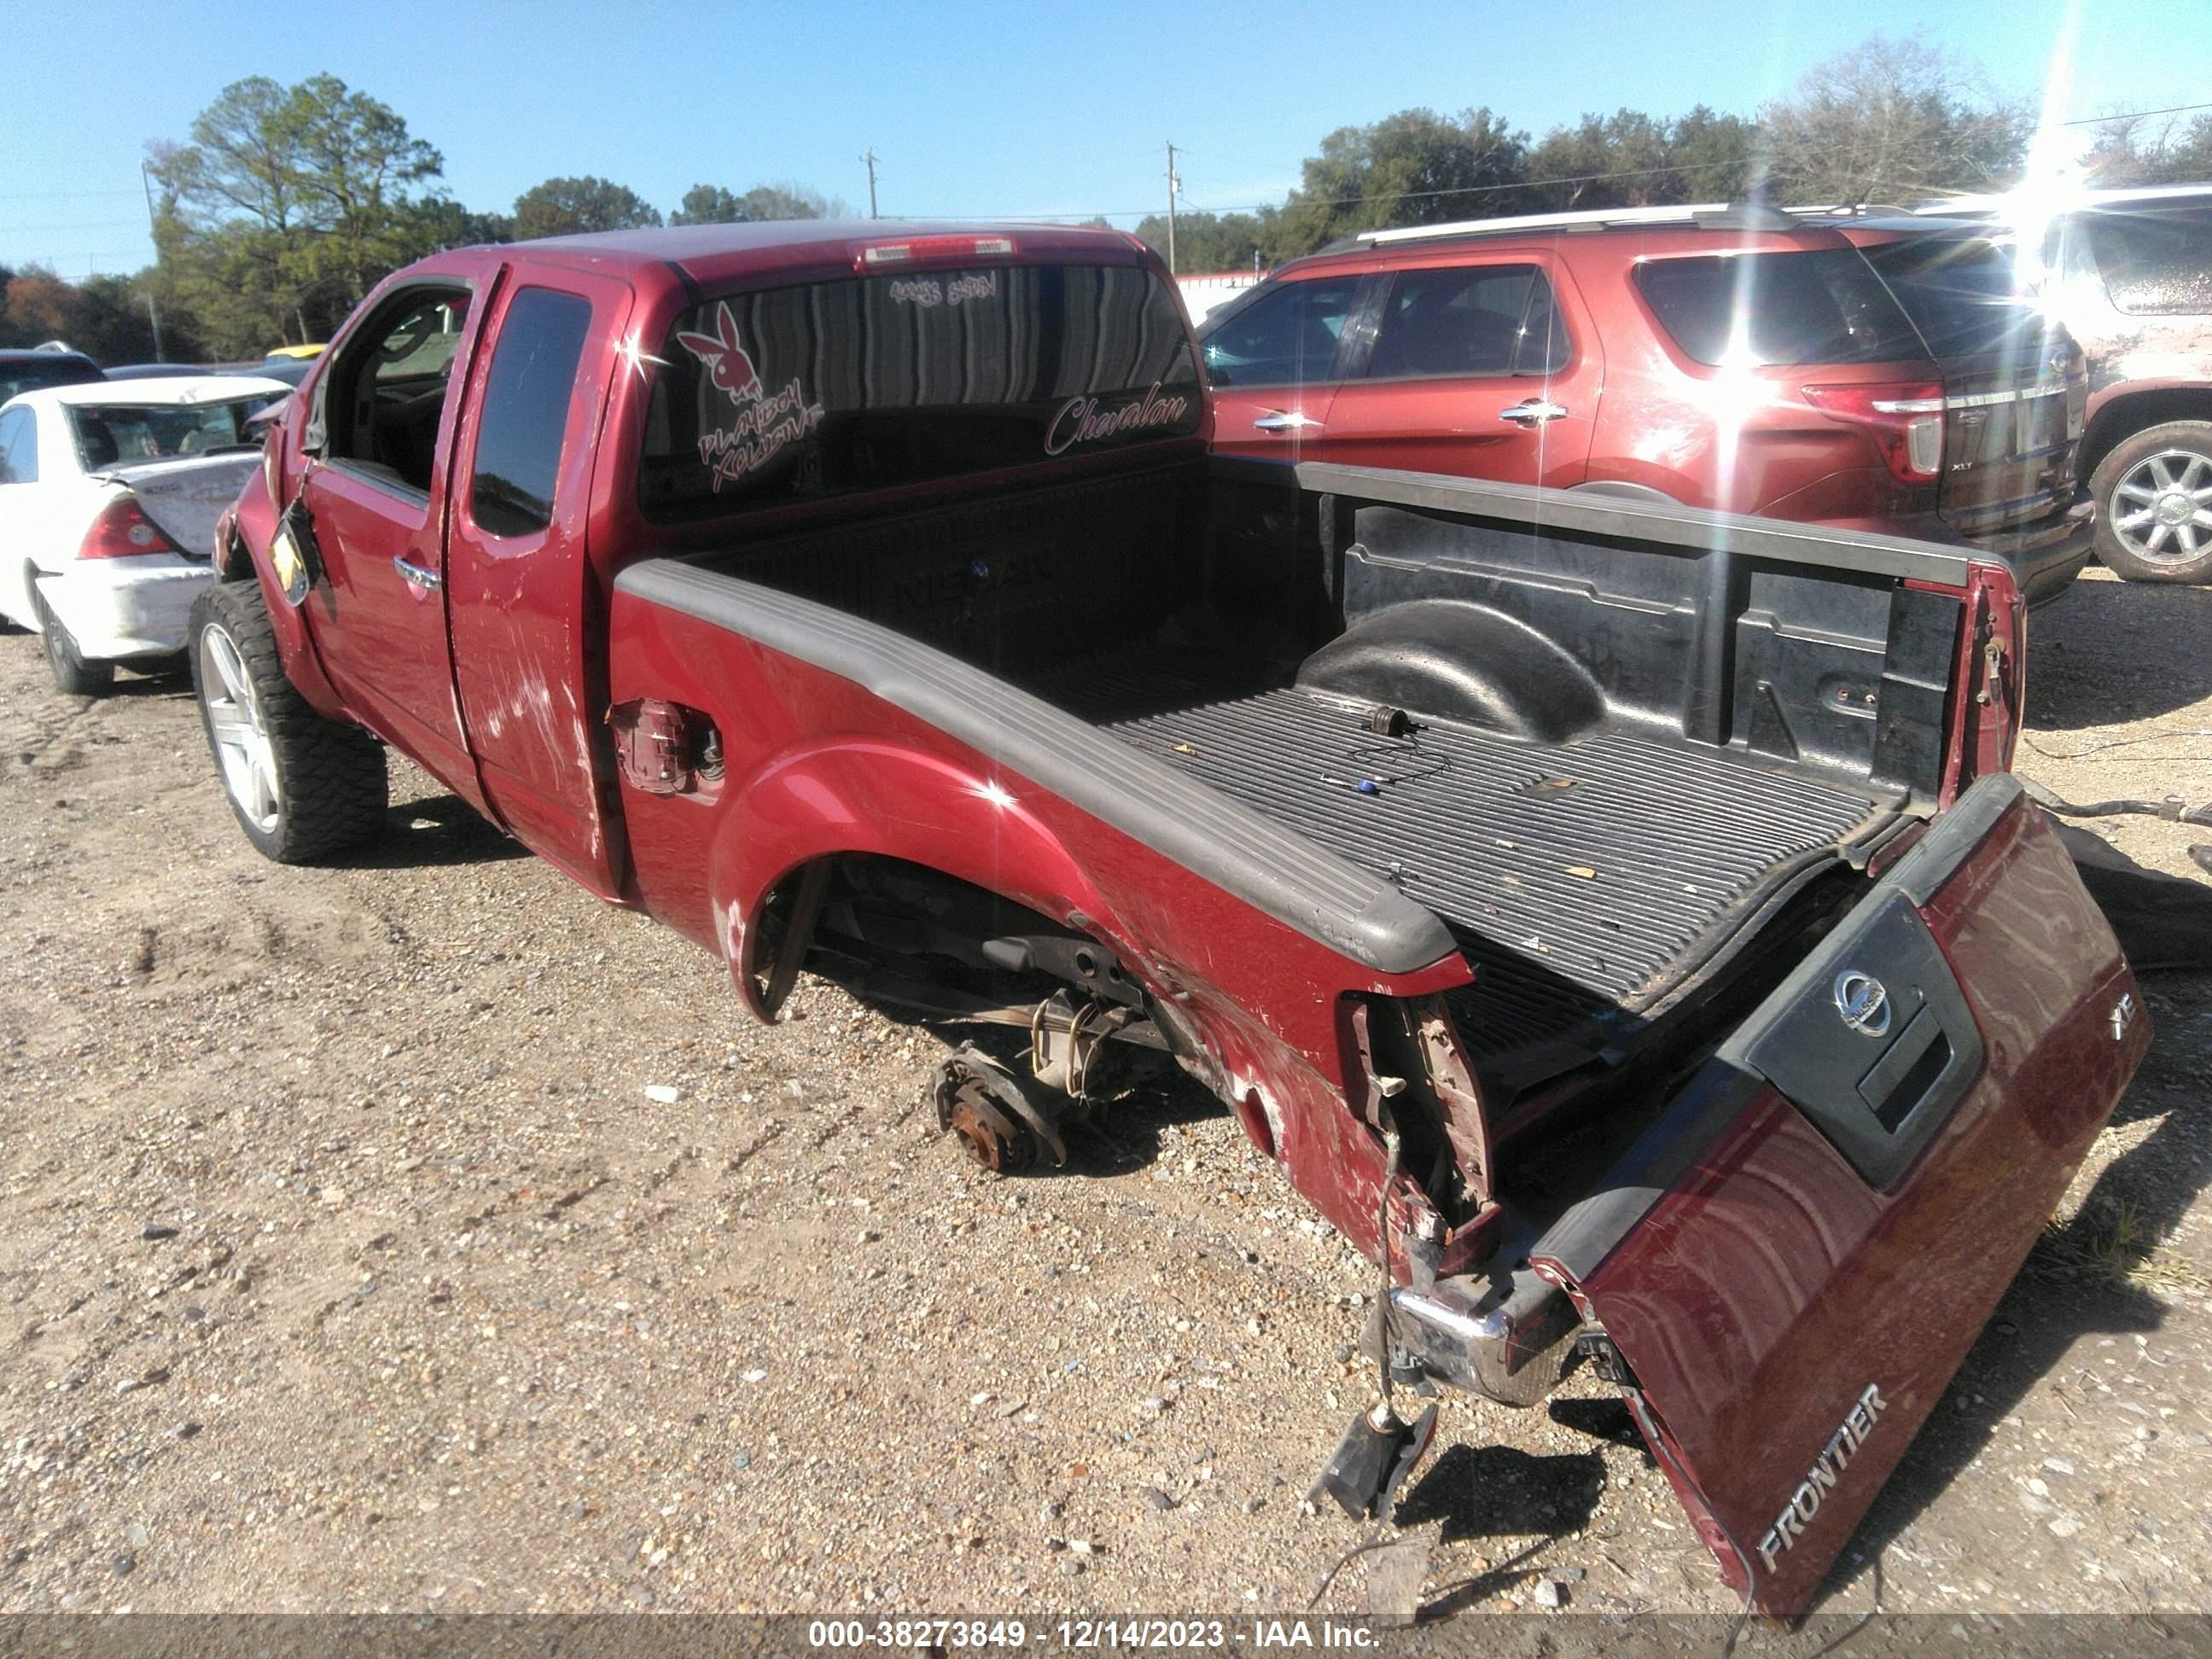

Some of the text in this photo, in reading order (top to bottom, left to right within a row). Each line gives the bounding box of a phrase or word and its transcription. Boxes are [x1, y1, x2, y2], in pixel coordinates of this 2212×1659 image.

[698, 377, 802, 465] PLAYBOY
[1044, 381, 1187, 456] Chevalon
[1951, 462, 1973, 472] XLT
[1850, 985, 1884, 1022] NISSAN
[1755, 1382, 1888, 1575] FRONTIER
